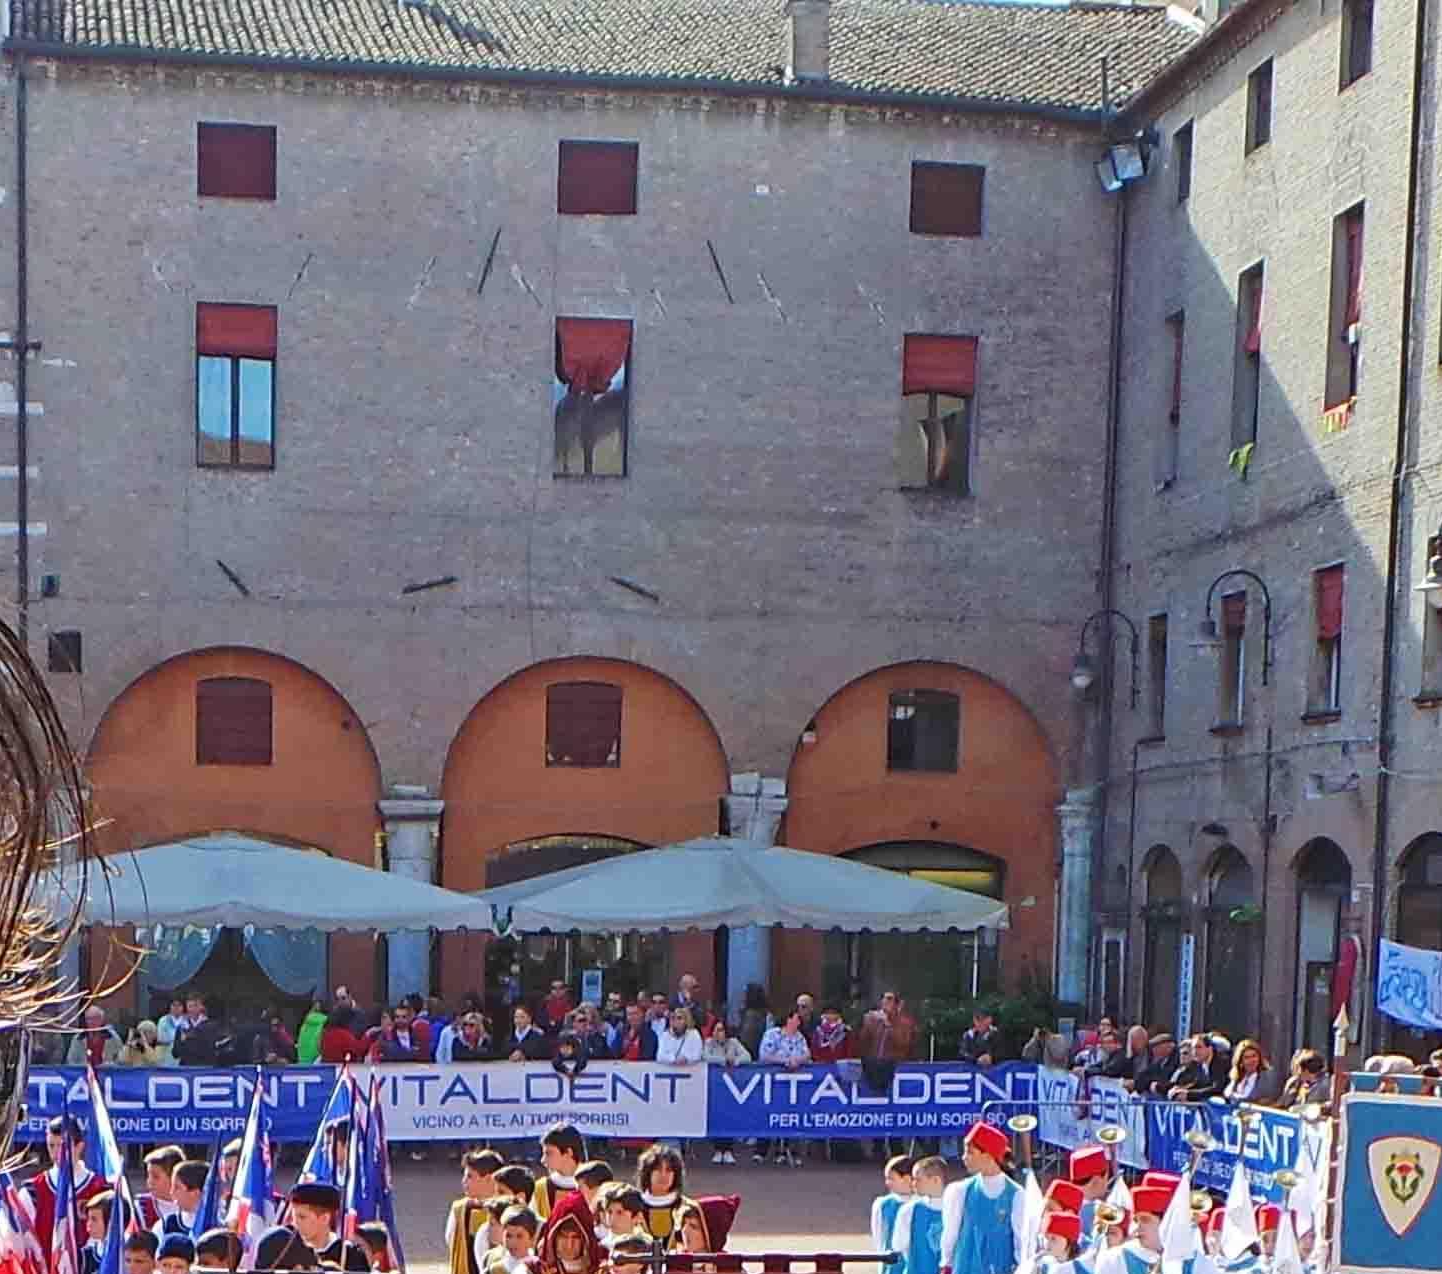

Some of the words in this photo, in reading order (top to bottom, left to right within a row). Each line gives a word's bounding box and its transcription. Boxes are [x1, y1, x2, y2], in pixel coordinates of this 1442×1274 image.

[28, 1075, 323, 1109] TALDENT
[154, 1117, 170, 1131] DI
[175, 1117, 197, 1131] UN
[412, 1114, 465, 1129] VICINO
[468, 1114, 480, 1128] A
[509, 1113, 525, 1127] AI
[570, 1112, 631, 1126] SORRISI
[769, 1113, 799, 1128] PER
[803, 1113, 894, 1128] L'EMOZIONE
[897, 1112, 913, 1127] DI
[916, 1112, 937, 1127] UN
